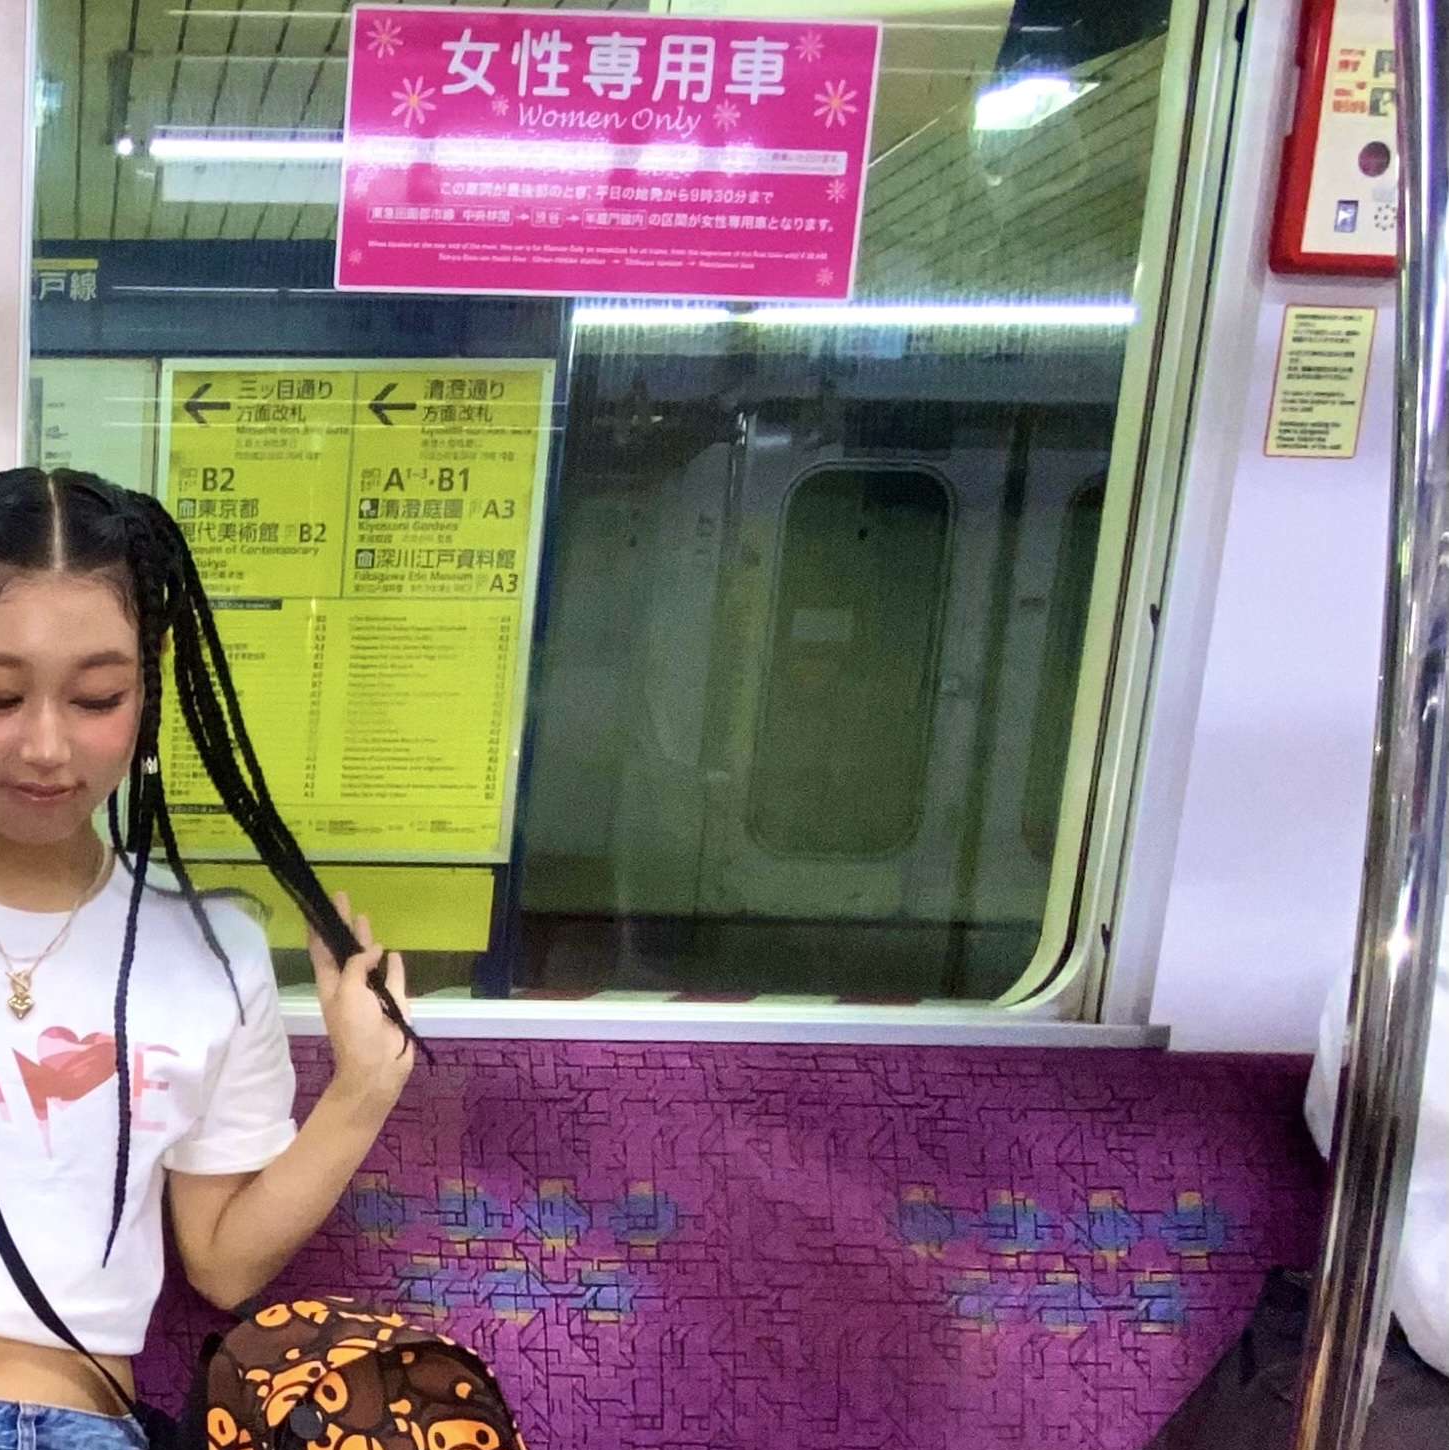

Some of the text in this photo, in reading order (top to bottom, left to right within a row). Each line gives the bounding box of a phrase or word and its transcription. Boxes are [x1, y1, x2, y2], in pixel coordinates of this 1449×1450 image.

[441, 28, 789, 105] 女性専用車
[518, 103, 702, 136] Women Only
[33, 272, 97, 300] 戸線
[424, 379, 504, 400] 清澄通り
[237, 404, 307, 422] 方面改札
[422, 404, 493, 422] 方面改札
[202, 467, 235, 492] B2
[198, 499, 259, 519] 東京都
[483, 499, 515, 519] A3
[299, 523, 327, 543] B2
[376, 549, 516, 569] 深川江戸資料館
[489, 573, 518, 593] A3
